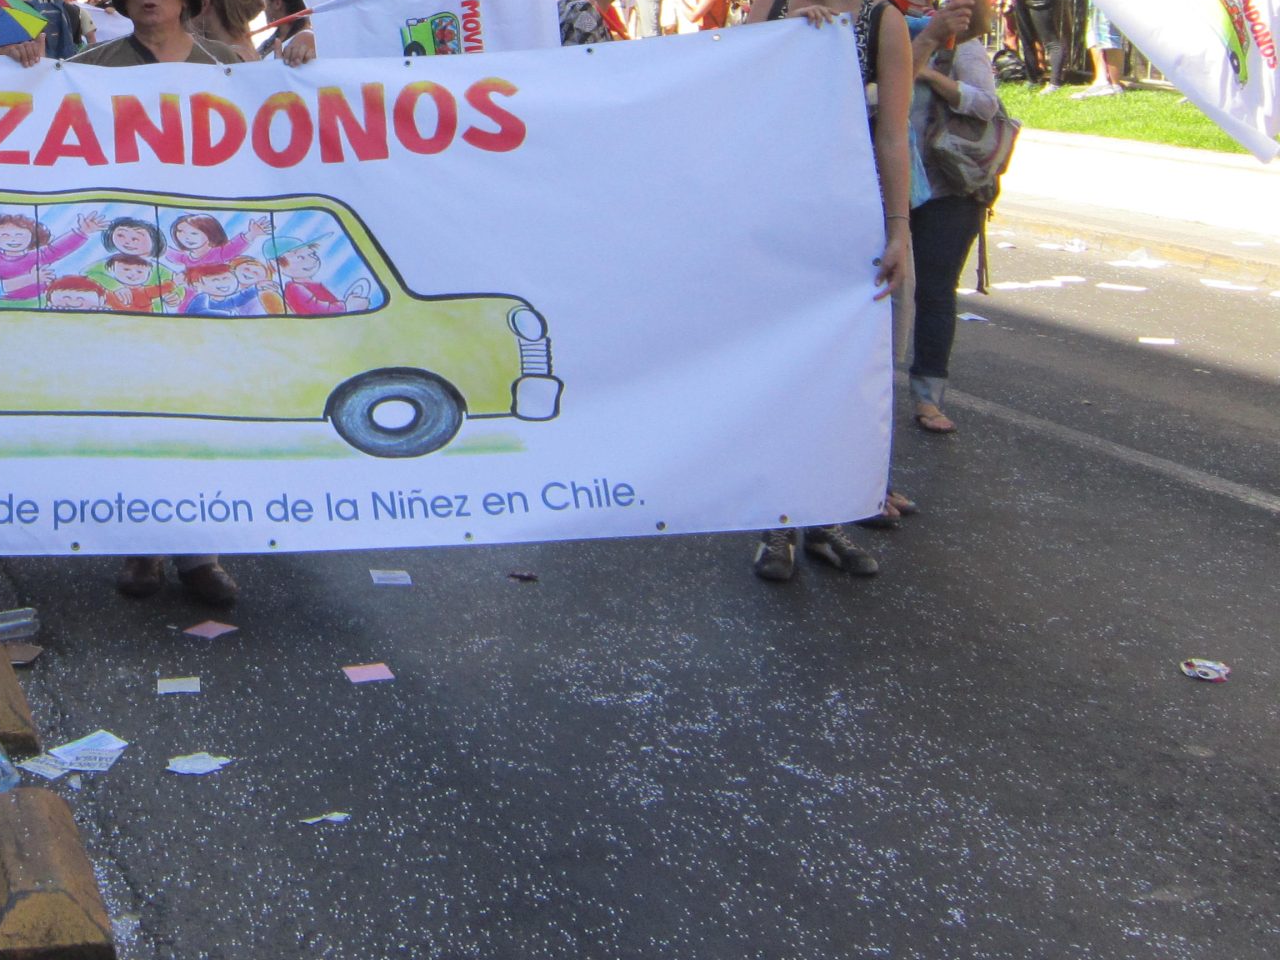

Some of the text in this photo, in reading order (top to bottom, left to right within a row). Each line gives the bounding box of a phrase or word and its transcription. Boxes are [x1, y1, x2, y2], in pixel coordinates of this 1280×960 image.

[53, 490, 253, 530] protección
[265, 493, 314, 523] de
[325, 492, 360, 521] la
[371, 489, 471, 521] Niñez
[482, 491, 528, 516] en
[540, 478, 645, 512] Chile.
